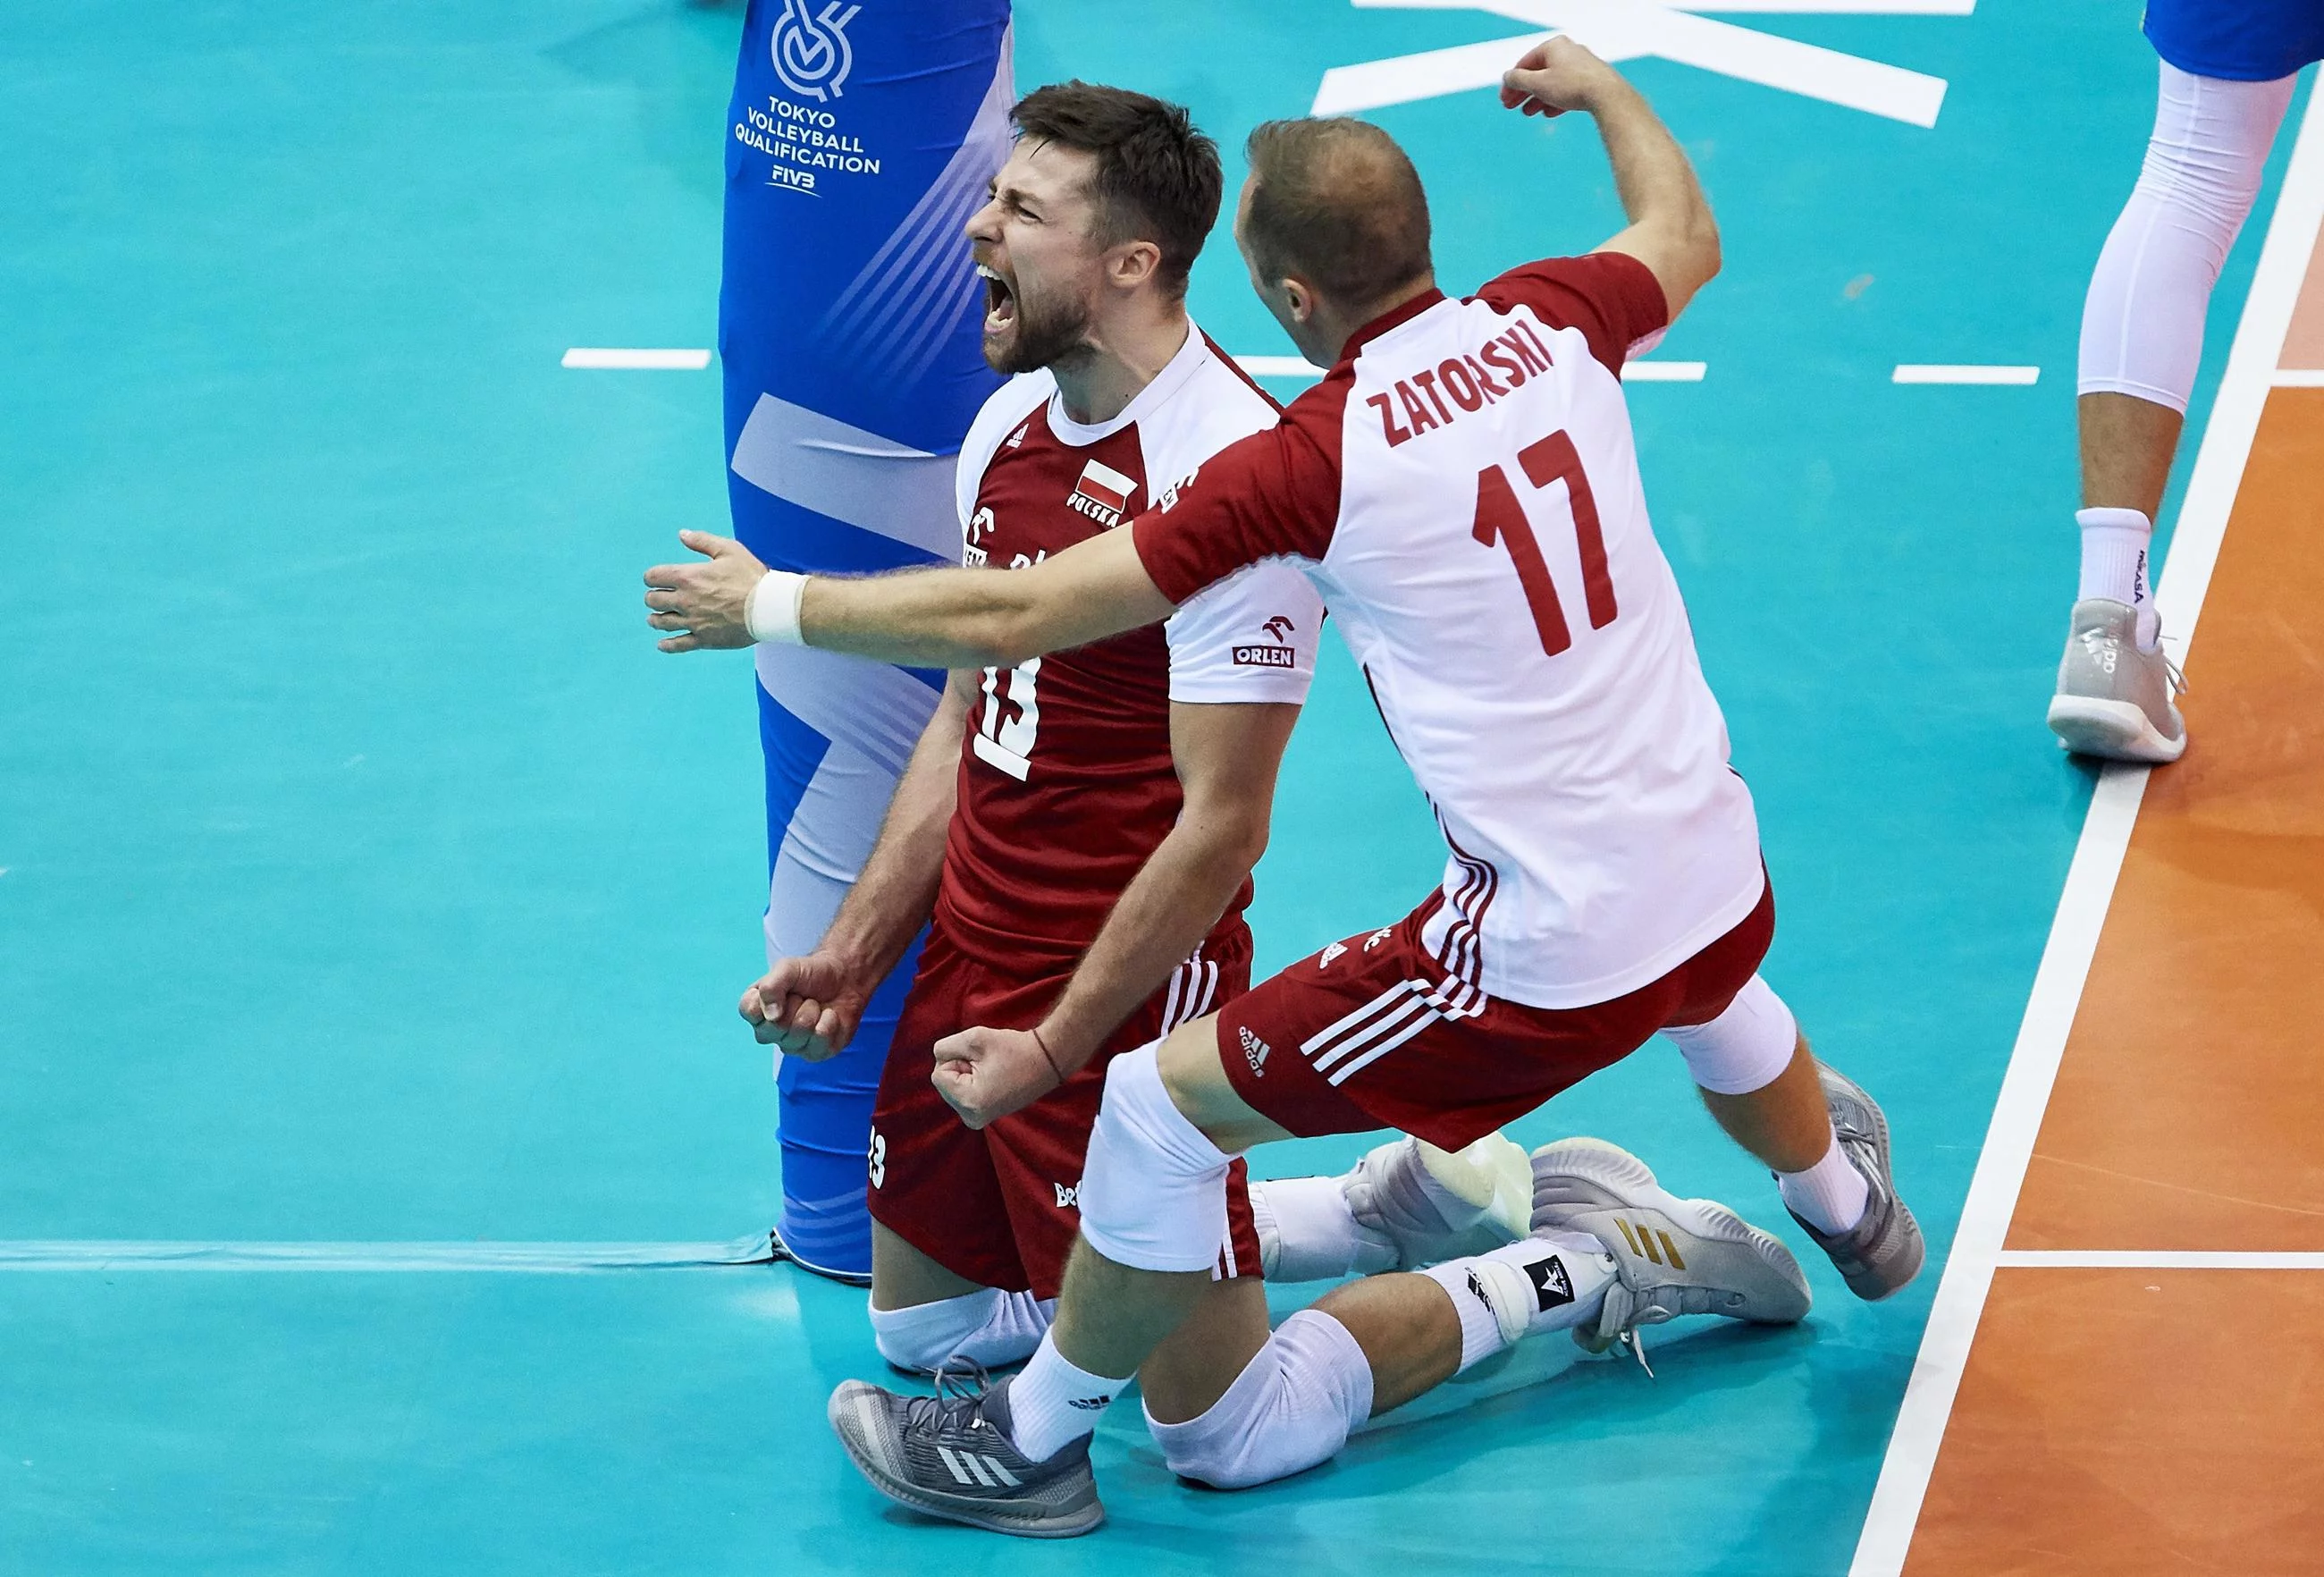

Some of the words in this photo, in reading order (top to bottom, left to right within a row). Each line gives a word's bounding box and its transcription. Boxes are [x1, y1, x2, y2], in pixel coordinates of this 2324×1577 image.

[747, 106, 864, 154] VOLLEYBALL
[769, 96, 837, 130] TOKYO
[735, 123, 880, 175] QUALIFICATION
[772, 164, 816, 189] FIVB
[1366, 318, 1554, 449] ZATORSKI
[1065, 493, 1121, 528] POLSKA
[1471, 428, 1619, 657] 17
[1236, 648, 1293, 665] ORLEN
[1238, 1025, 1266, 1078] adidas
[867, 1125, 886, 1190] 13
